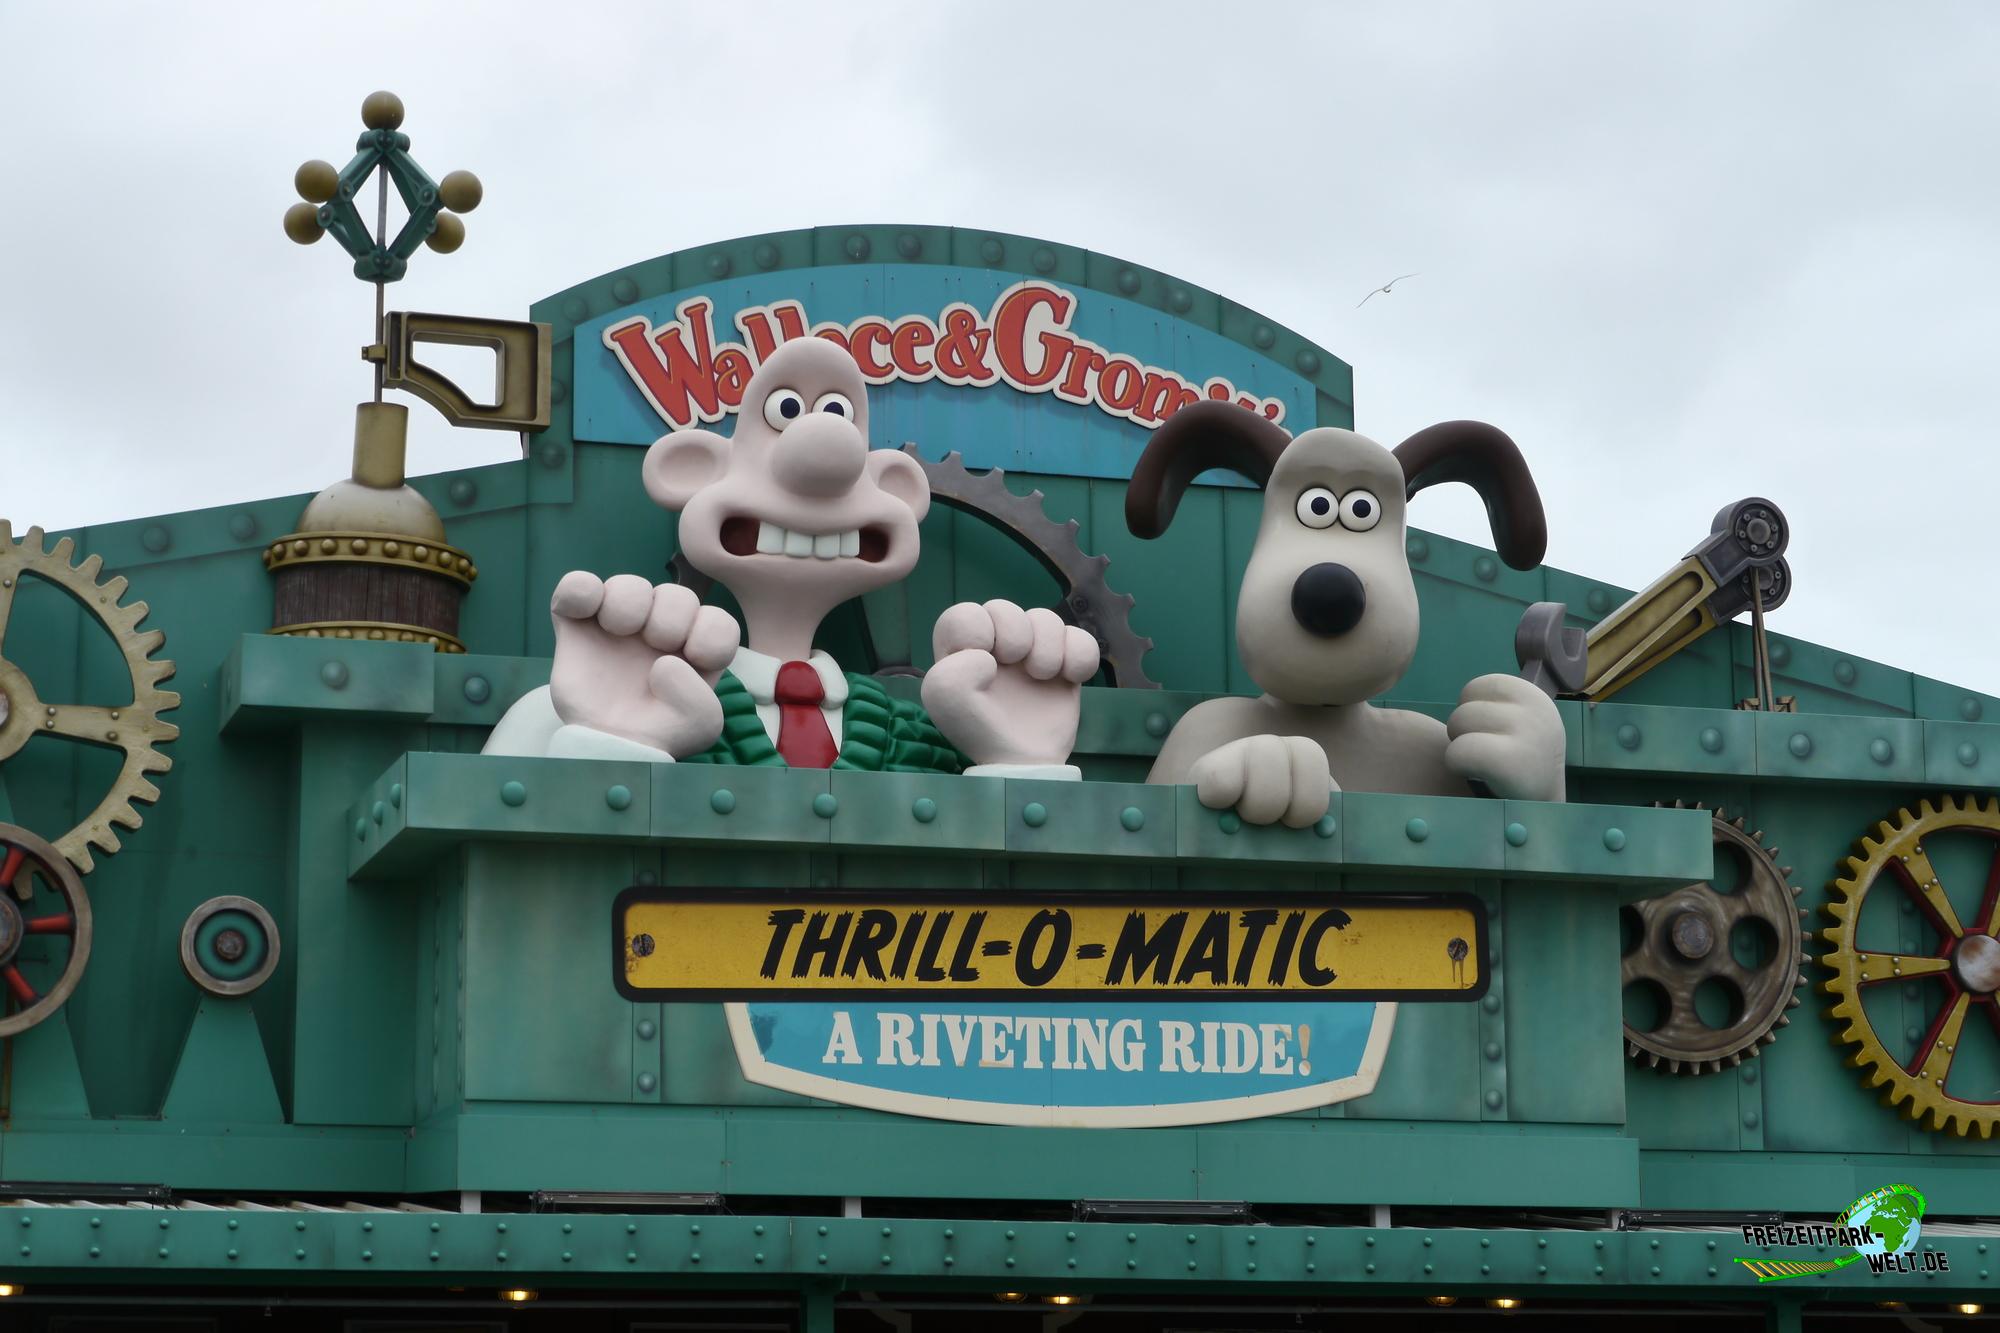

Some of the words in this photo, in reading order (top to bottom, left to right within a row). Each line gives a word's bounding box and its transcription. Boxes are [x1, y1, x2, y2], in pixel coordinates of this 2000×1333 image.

[822, 1011, 863, 1064] A
[876, 1012, 1146, 1072] RIVETING
[1159, 1020, 1312, 1077] RIDE!
